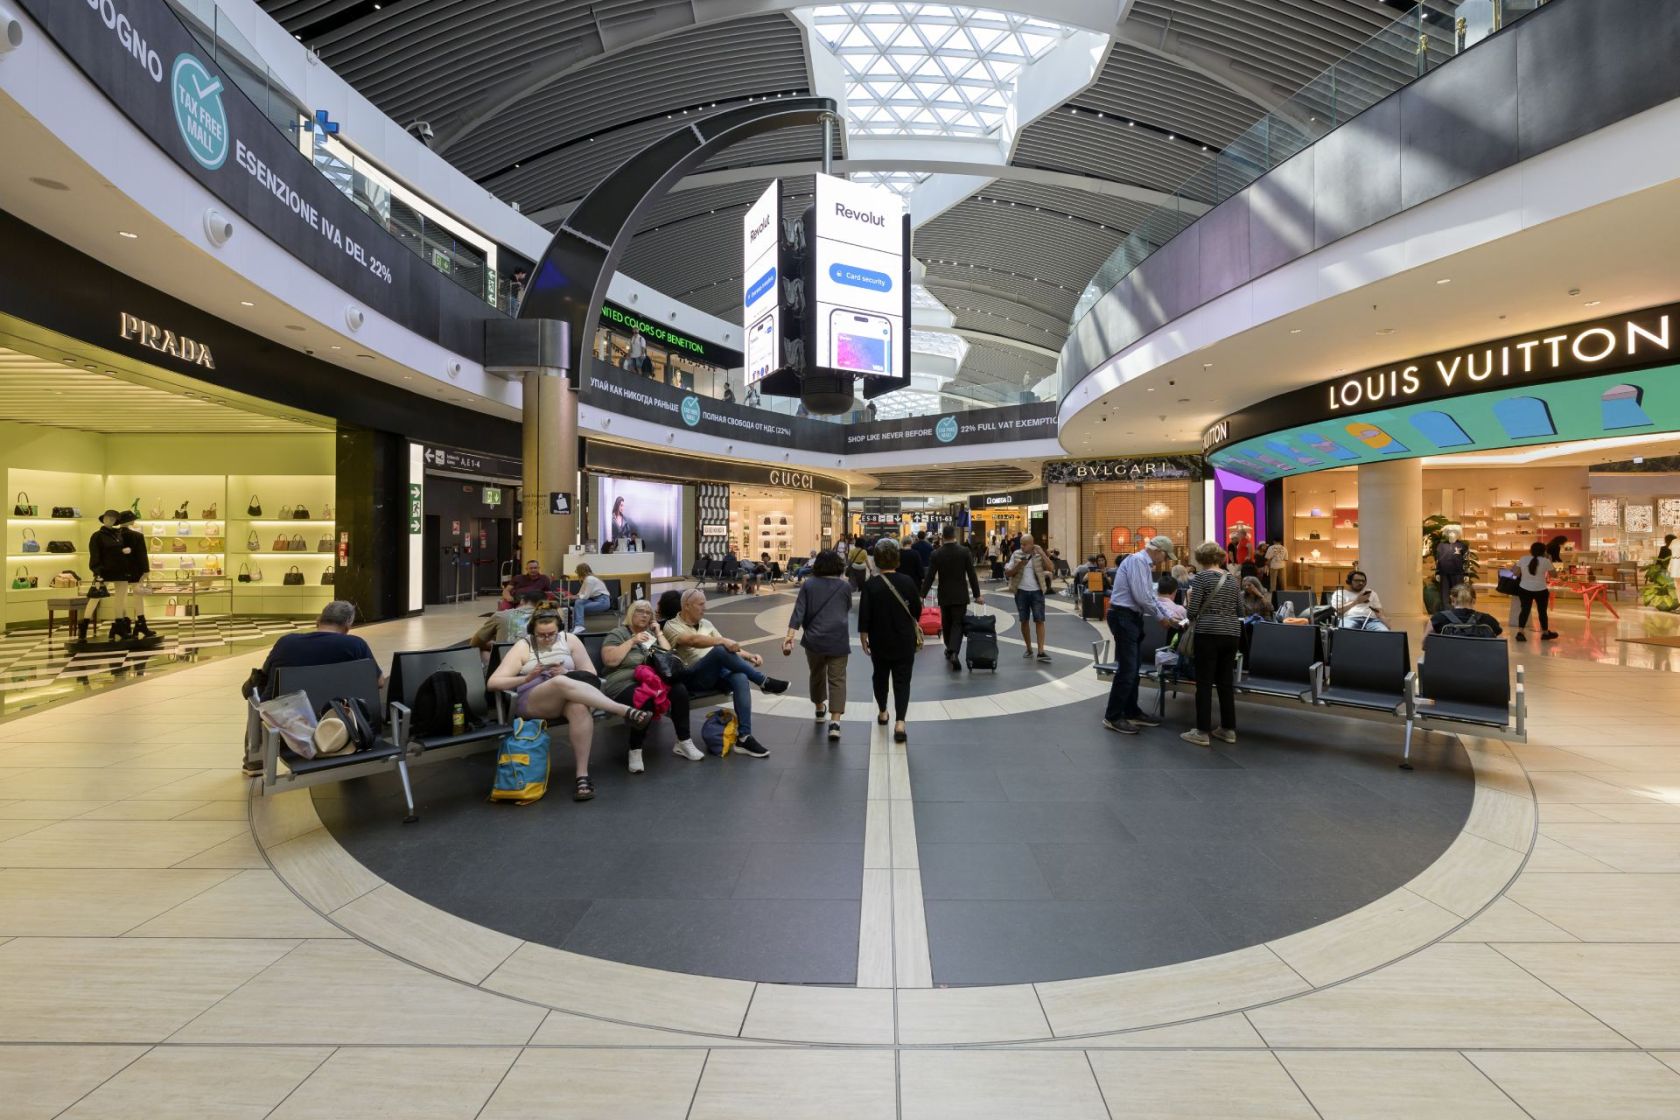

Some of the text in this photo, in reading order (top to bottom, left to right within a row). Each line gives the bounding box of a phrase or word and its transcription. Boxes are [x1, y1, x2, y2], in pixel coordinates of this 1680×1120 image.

[178, 84, 222, 141] TAX FREE
[187, 115, 213, 154] MALL
[236, 139, 392, 284] ESENZIONE IVA DEL 22%
[835, 202, 886, 228] Revolut
[750, 214, 771, 244] Revolut
[846, 272, 886, 287] Card security
[119, 311, 216, 369] PRADA
[624, 316, 655, 336] COLORS
[655, 329, 666, 340] OF
[1329, 314, 1670, 411] LOUIS VUITTON
[609, 384, 623, 397] КАК
[623, 389, 654, 406] НИКОГДА
[653, 397, 680, 413] РАНЬШЕ
[702, 411, 727, 424] ПОЛНАЯ
[727, 416, 755, 430] СВОБОДА
[755, 423, 764, 431] ОТ
[763, 425, 776, 434] НДС
[847, 435, 866, 443] SHOP
[866, 433, 881, 442] LIKE
[881, 431, 904, 440] NEVER
[904, 428, 933, 438] BEFORE
[960, 424, 976, 433] 22%
[977, 422, 997, 431] FULL
[998, 420, 1014, 429] VAT
[769, 470, 814, 489] GUCCI
[1077, 462, 1167, 477] BVLGARI
